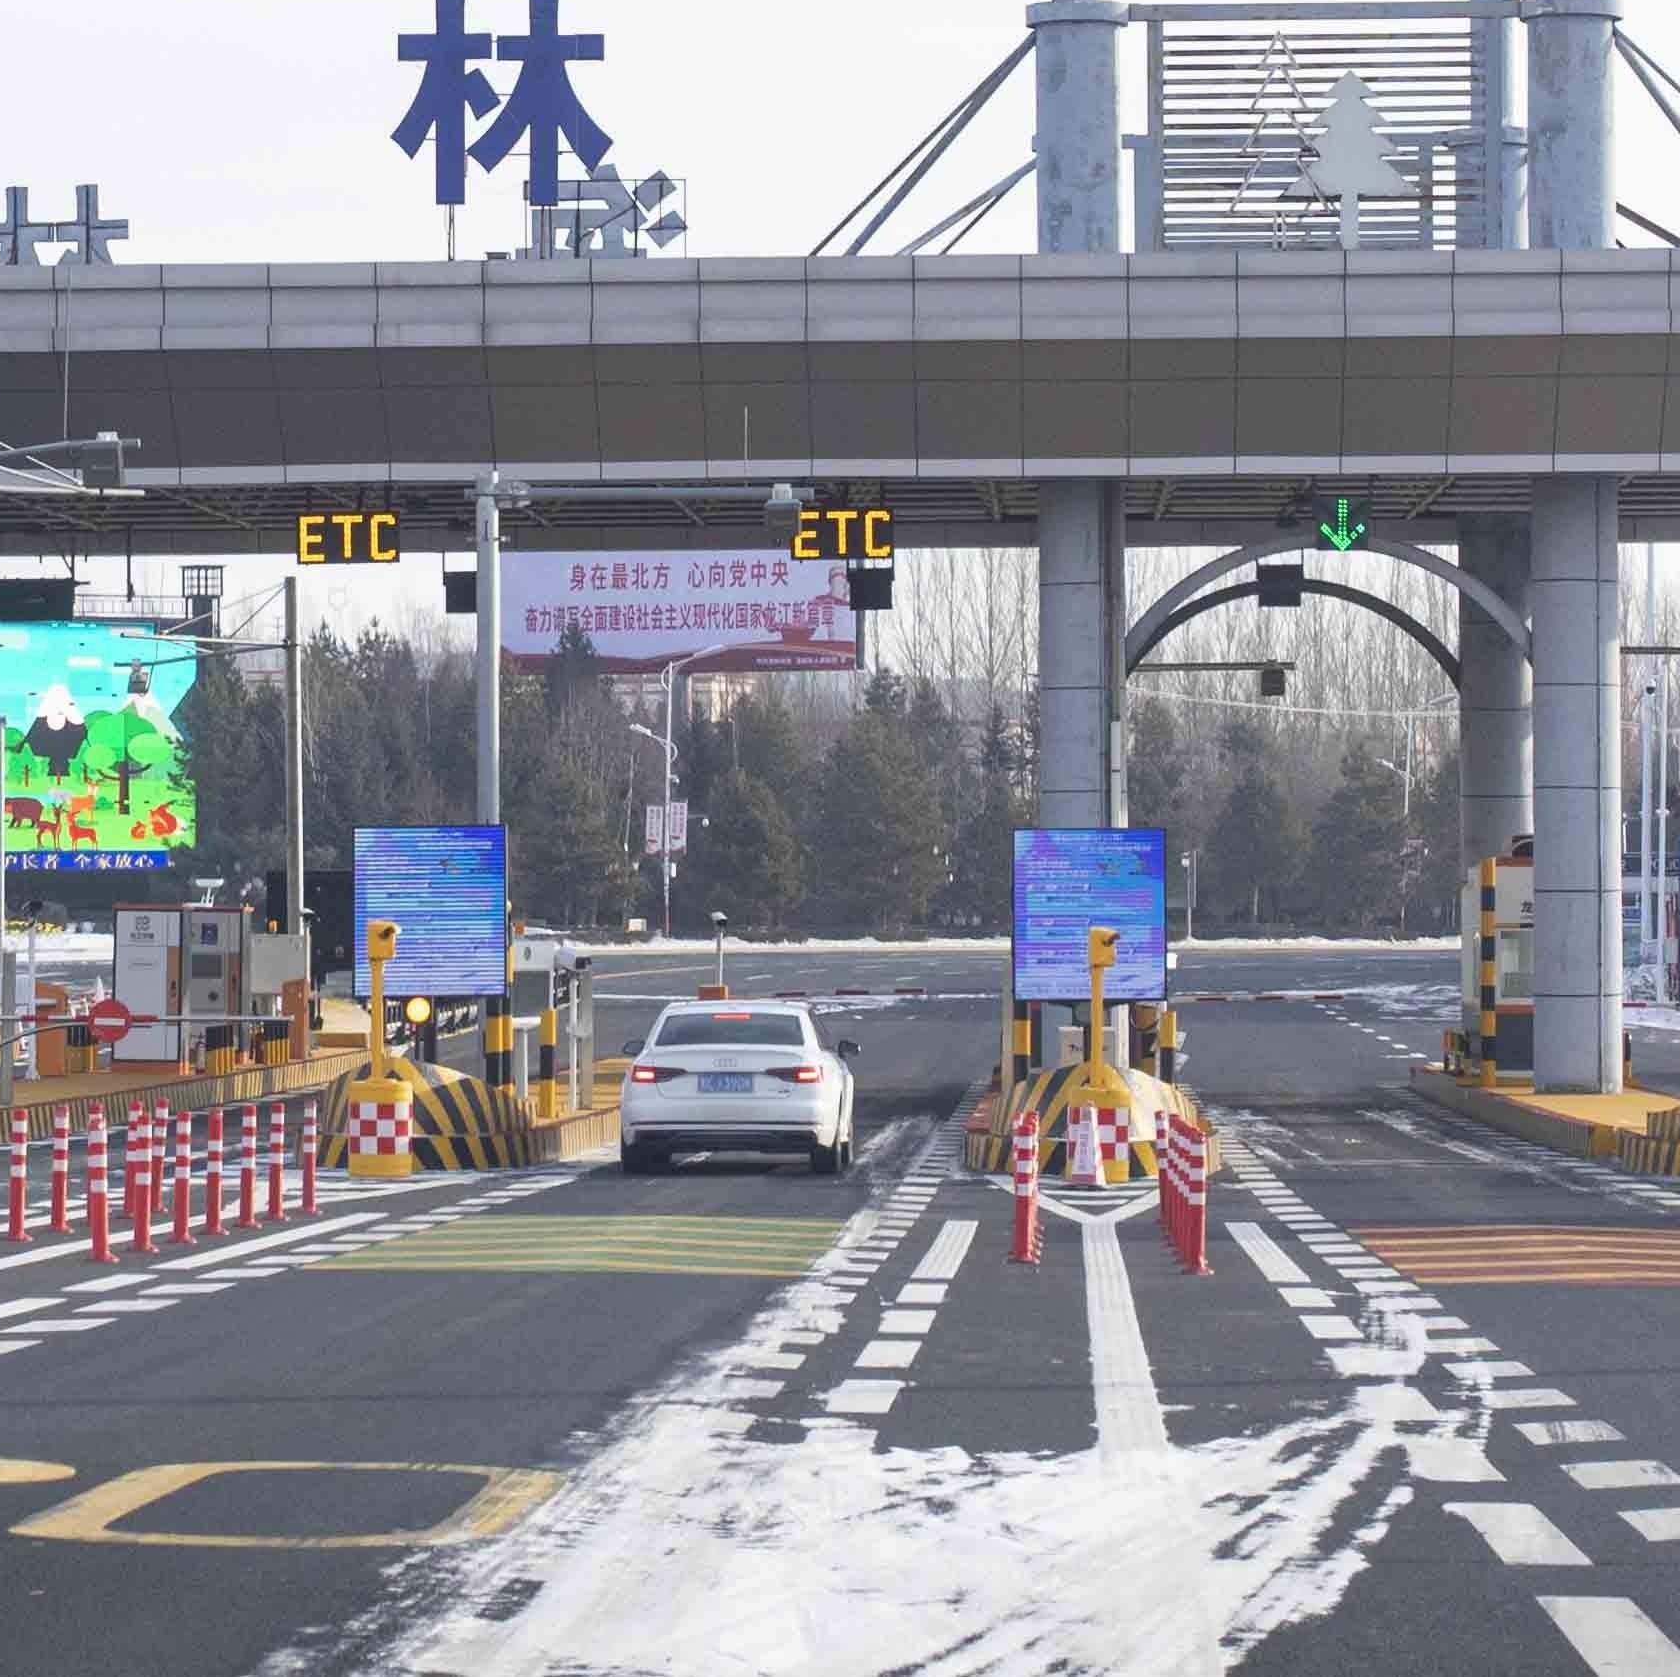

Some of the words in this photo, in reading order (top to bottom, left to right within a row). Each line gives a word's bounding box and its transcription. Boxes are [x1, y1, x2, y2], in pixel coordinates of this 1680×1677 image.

[298, 514, 397, 562] ETC
[792, 510, 892, 559] ETC
[569, 562, 671, 591] 身在最北方
[688, 560, 789, 589] 心向党中央
